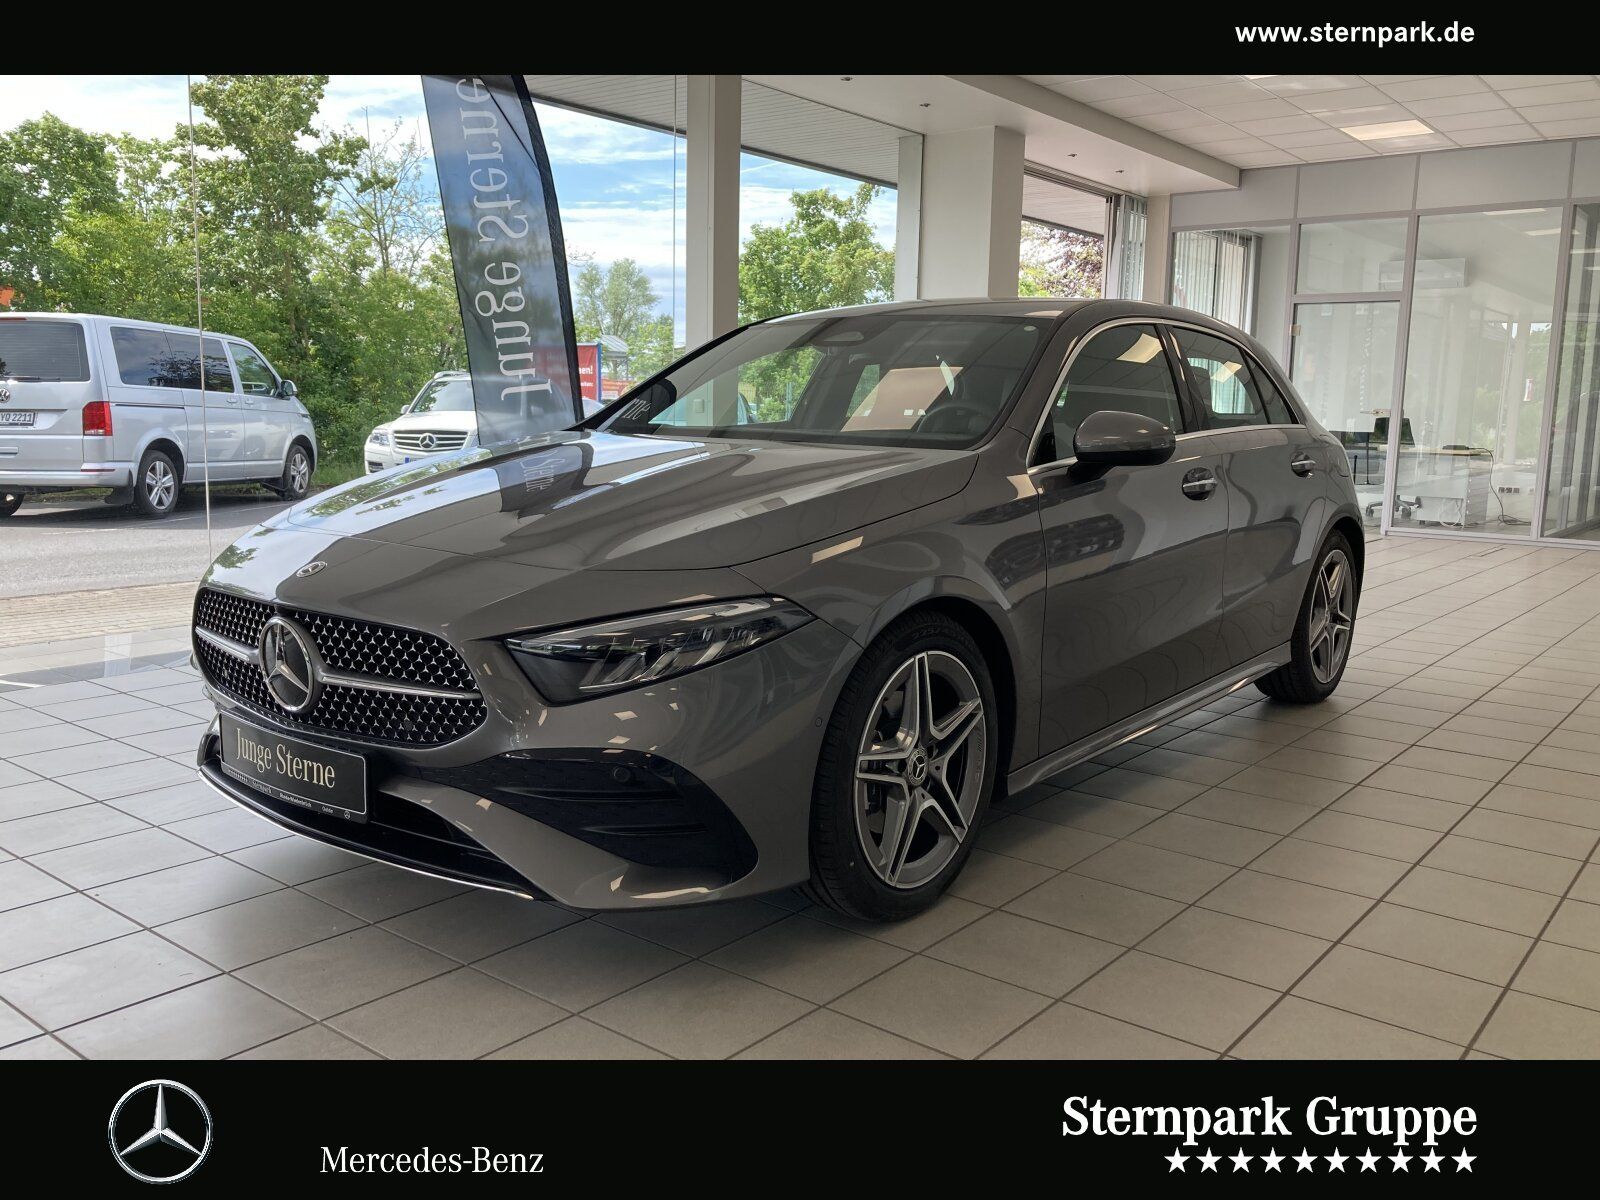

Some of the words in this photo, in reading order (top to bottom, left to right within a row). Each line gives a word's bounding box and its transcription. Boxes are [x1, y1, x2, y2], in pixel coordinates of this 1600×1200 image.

[12, 411, 32, 422] 2211
[236, 728, 271, 773] Junge
[276, 743, 335, 788] Sterne
